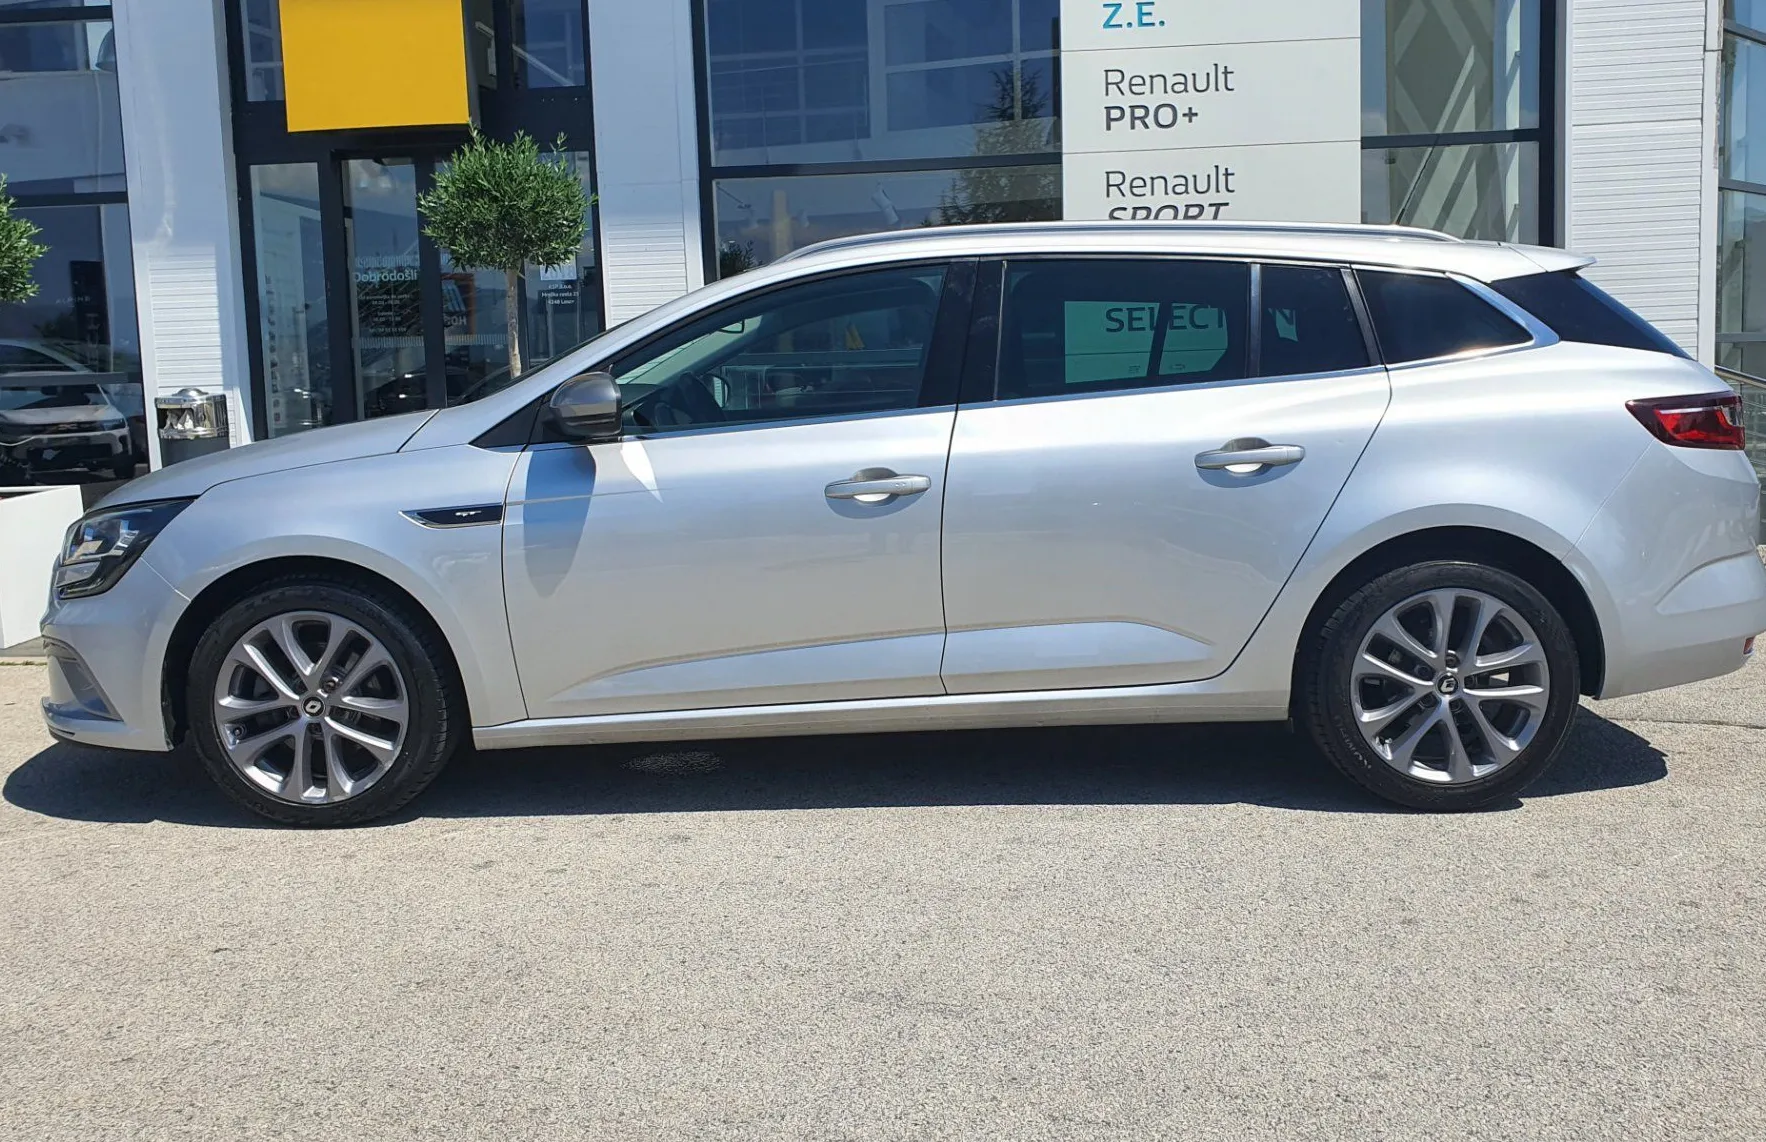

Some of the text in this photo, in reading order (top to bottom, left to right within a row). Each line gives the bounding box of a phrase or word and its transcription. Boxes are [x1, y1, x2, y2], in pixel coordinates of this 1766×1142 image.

[1102, 2, 1165, 29] Z.E.
[1103, 63, 1235, 97] Renault
[1104, 103, 1199, 131] PRO+
[1104, 165, 1236, 198] Renault
